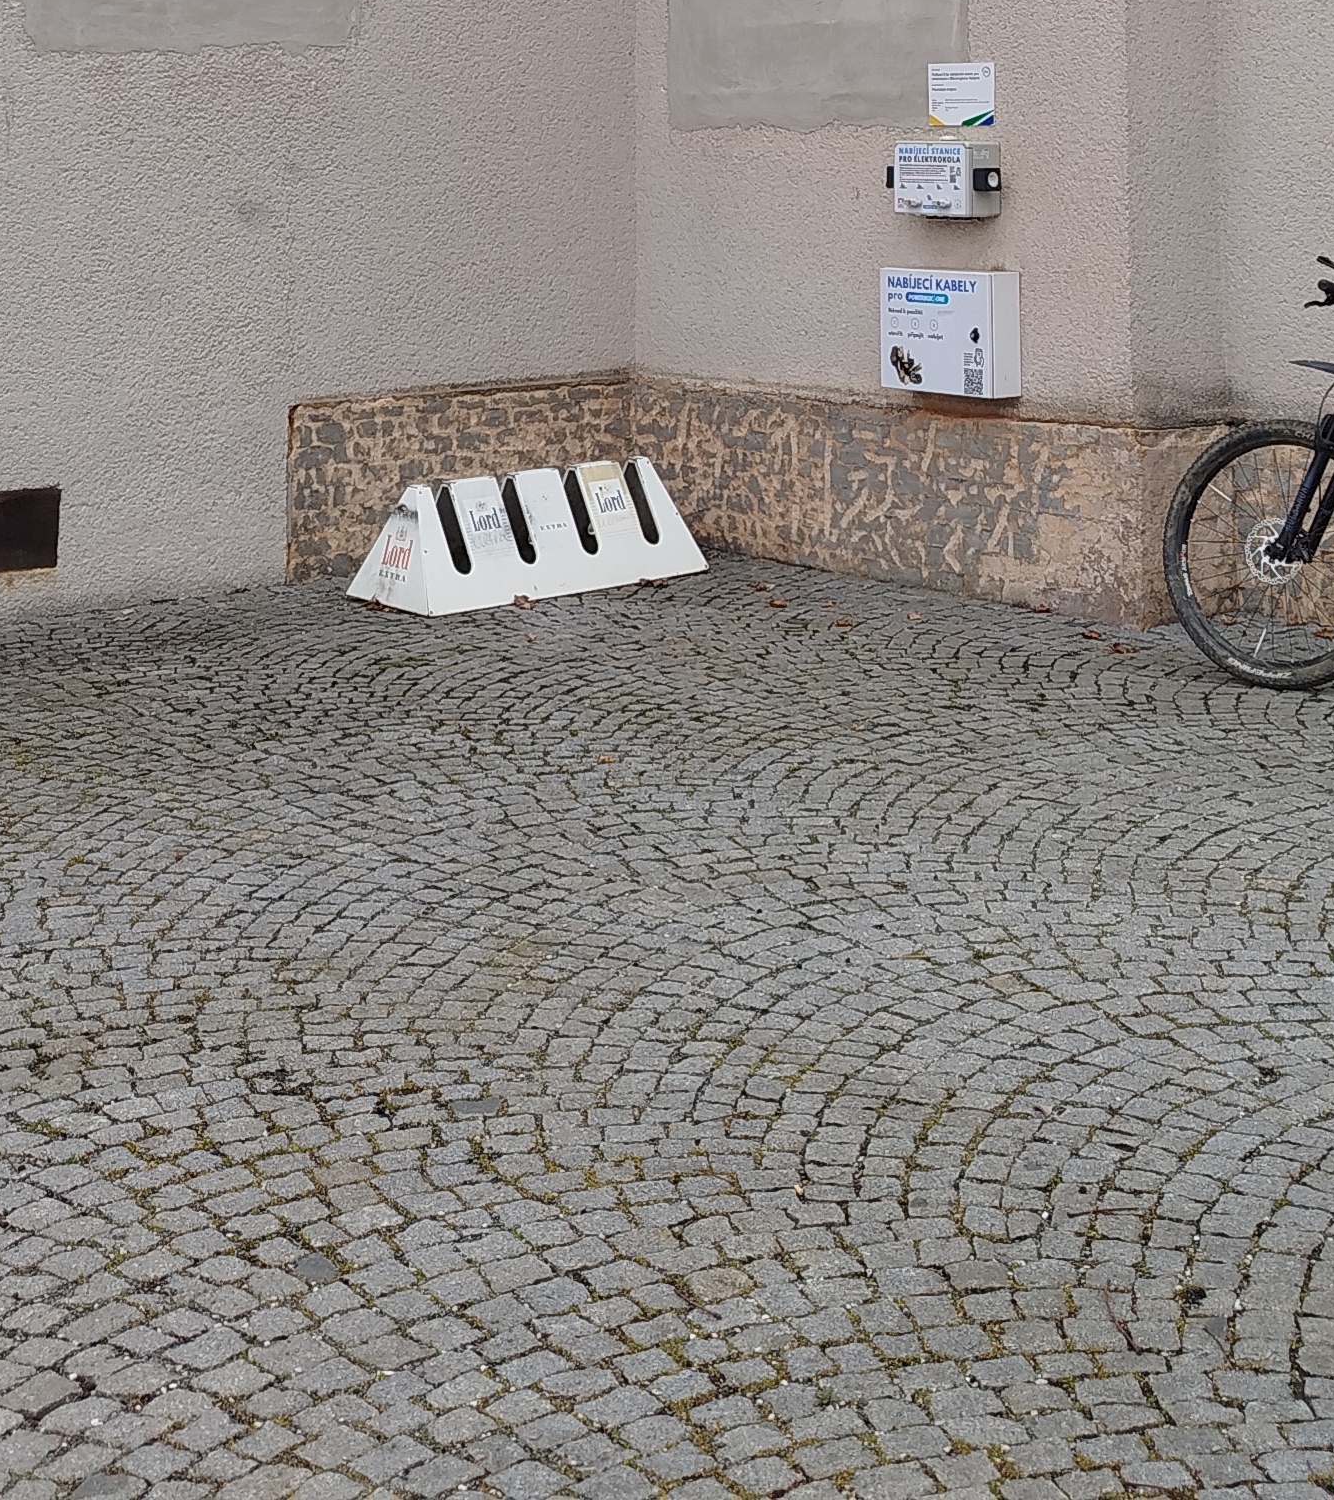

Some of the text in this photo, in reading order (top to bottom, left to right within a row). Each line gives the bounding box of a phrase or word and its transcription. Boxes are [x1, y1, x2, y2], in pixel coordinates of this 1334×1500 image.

[931, 147, 961, 156] STANICE
[887, 273, 977, 293] NABÍJECÍ KABELY
[888, 292, 903, 302] pro
[594, 489, 627, 513] Lord
[468, 507, 503, 532] Lord
[381, 534, 414, 570] Lord
[378, 569, 406, 583] EXTRA
